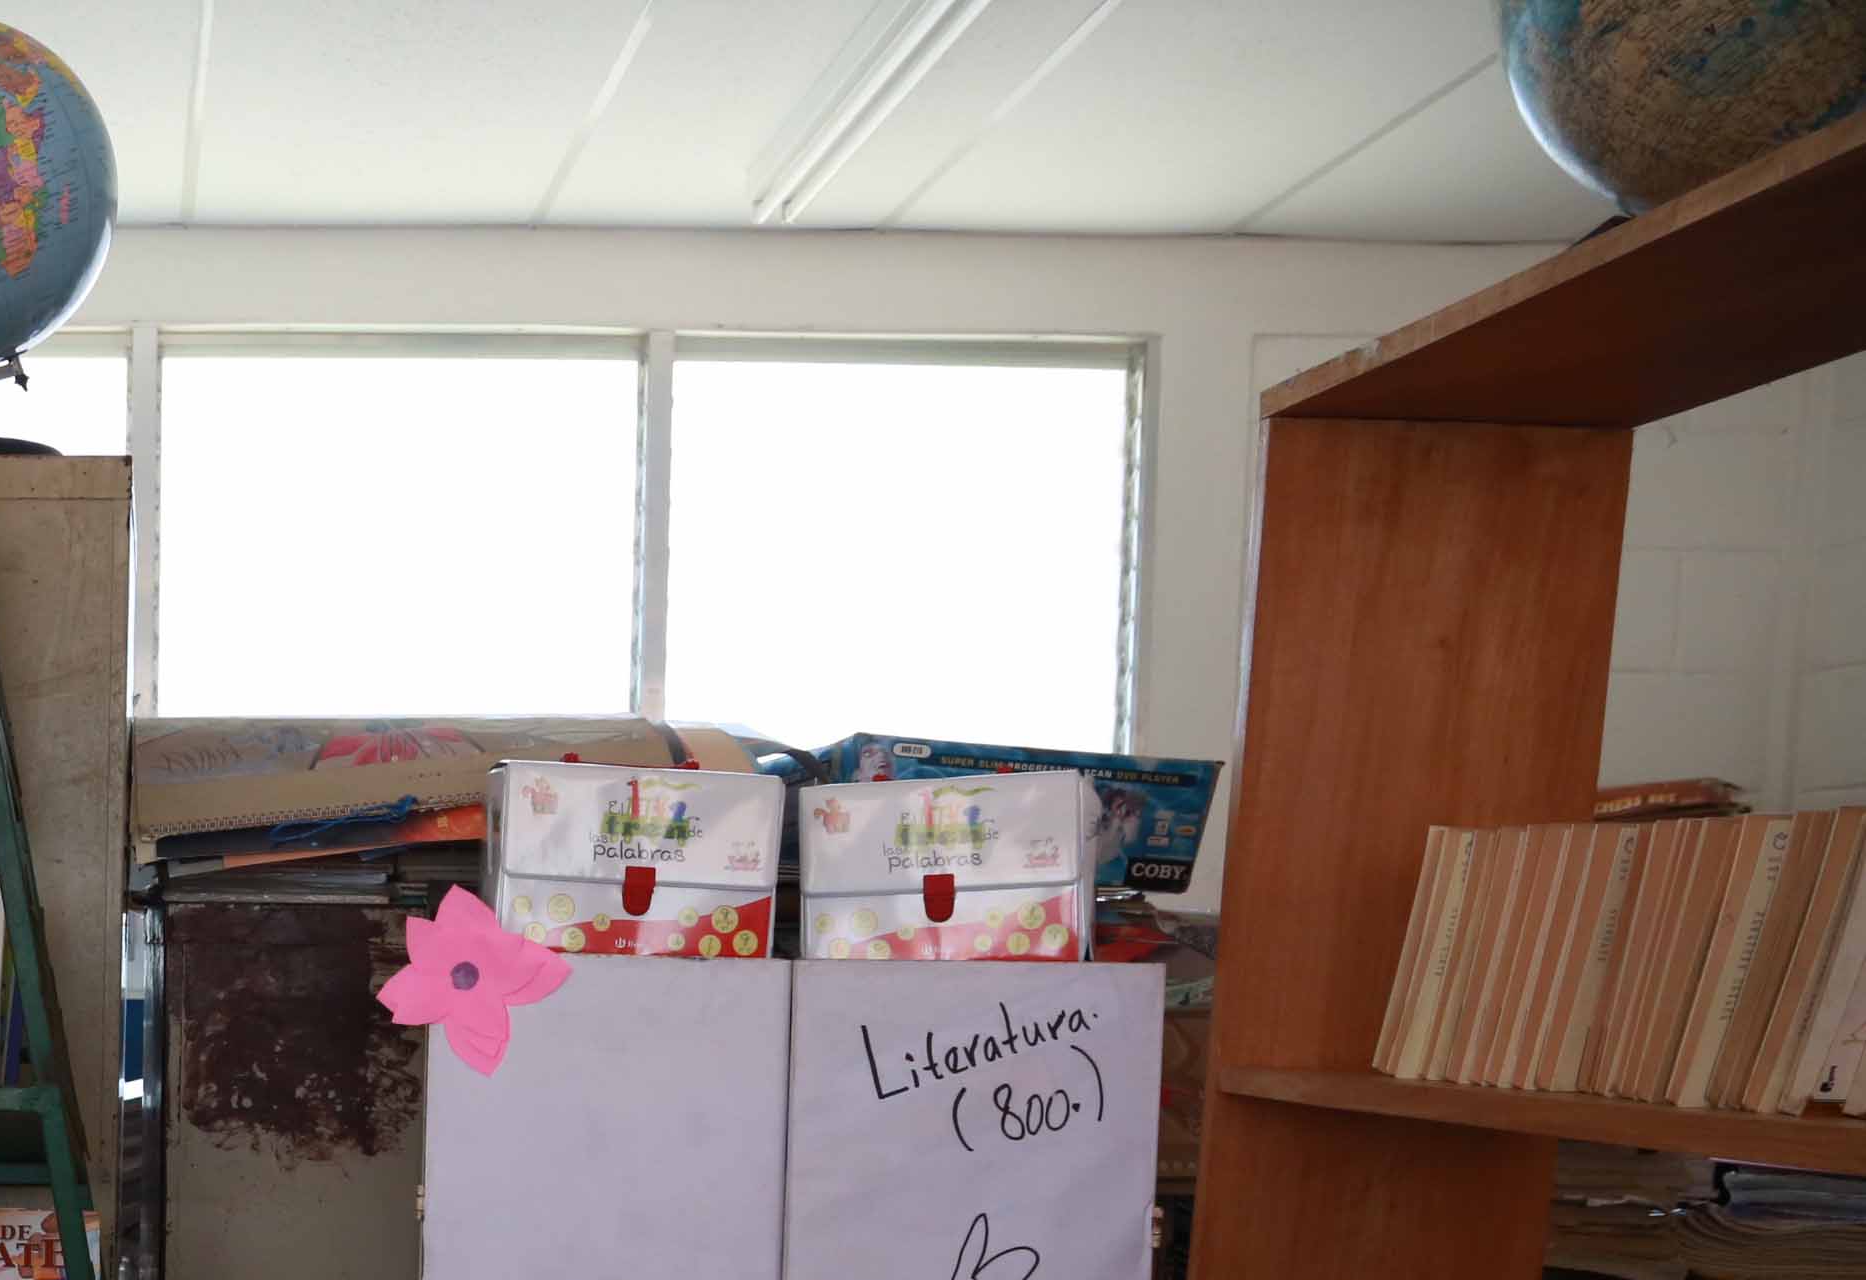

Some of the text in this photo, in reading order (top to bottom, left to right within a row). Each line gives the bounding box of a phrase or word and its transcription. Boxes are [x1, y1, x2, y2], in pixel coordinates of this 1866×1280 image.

[940, 756, 974, 768] SUPER
[593, 839, 686, 863] palabras
[887, 849, 984, 873] palabras
[860, 1001, 1099, 1099] Literatura.
[0, 1223, 31, 1241] DE
